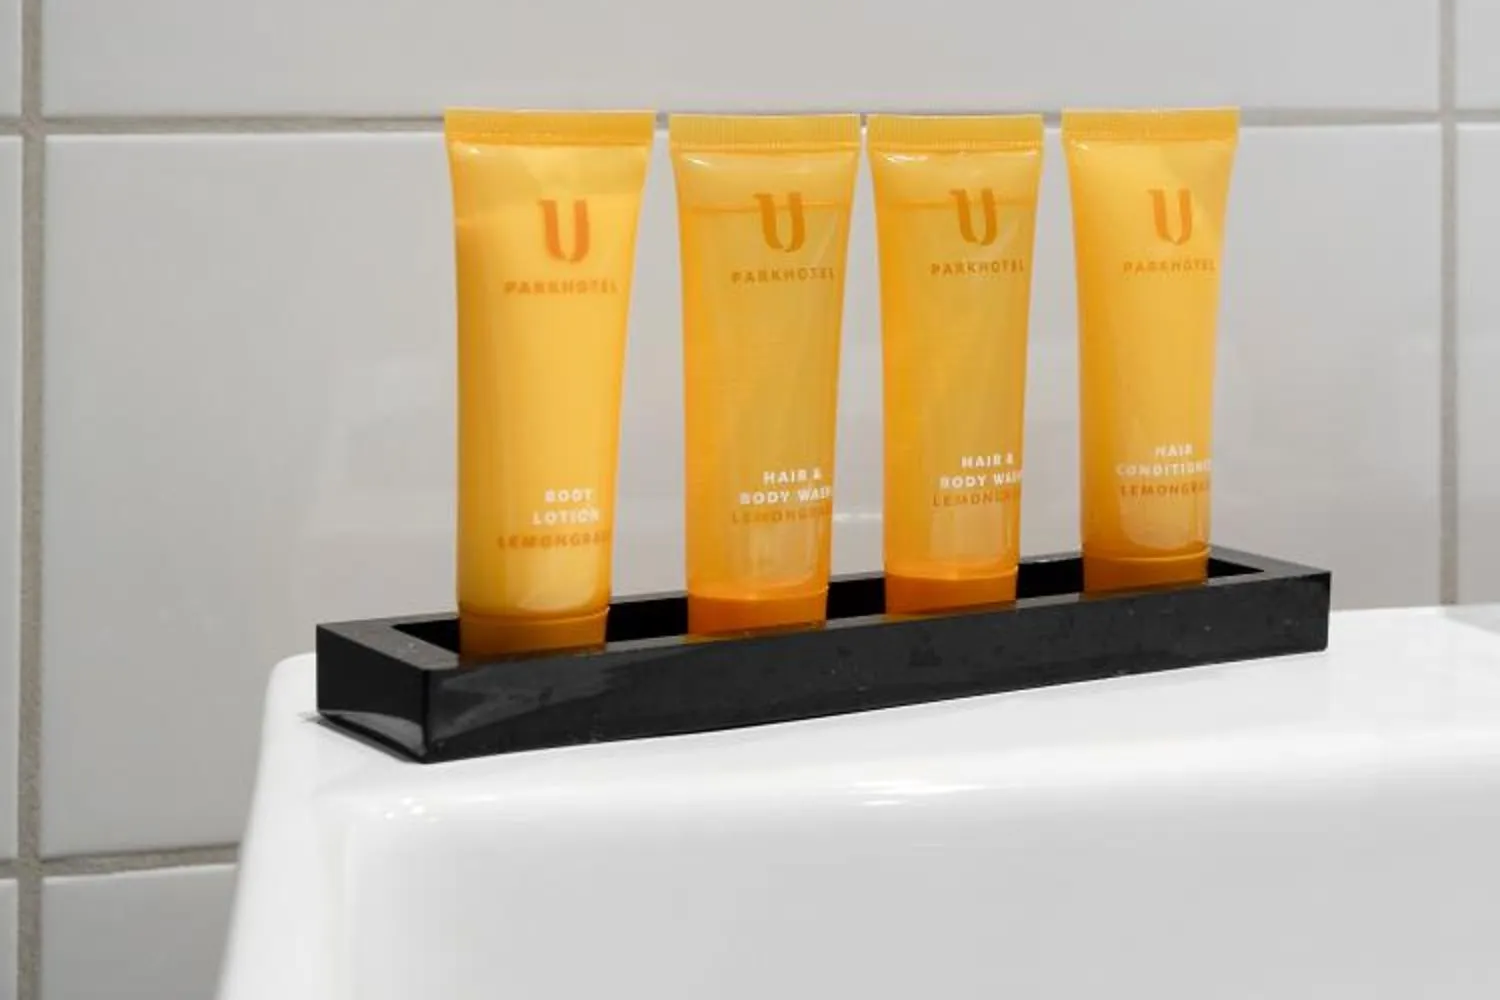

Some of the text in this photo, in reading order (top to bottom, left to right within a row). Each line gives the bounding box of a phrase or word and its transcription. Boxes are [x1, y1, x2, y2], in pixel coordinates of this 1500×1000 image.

[930, 259, 1024, 276] PARKHOTEL
[1122, 259, 1216, 274] PARKHOTEL
[730, 267, 835, 284] PARKHOTEL
[503, 279, 619, 295] PARKHOTEL
[1154, 443, 1193, 457] HAIR
[960, 454, 1001, 469] HAIR
[762, 468, 807, 485] HAIR
[939, 475, 986, 489] BODY
[544, 488, 593, 504] BODY
[738, 490, 789, 505] BODY
[531, 507, 600, 526] LOTION
